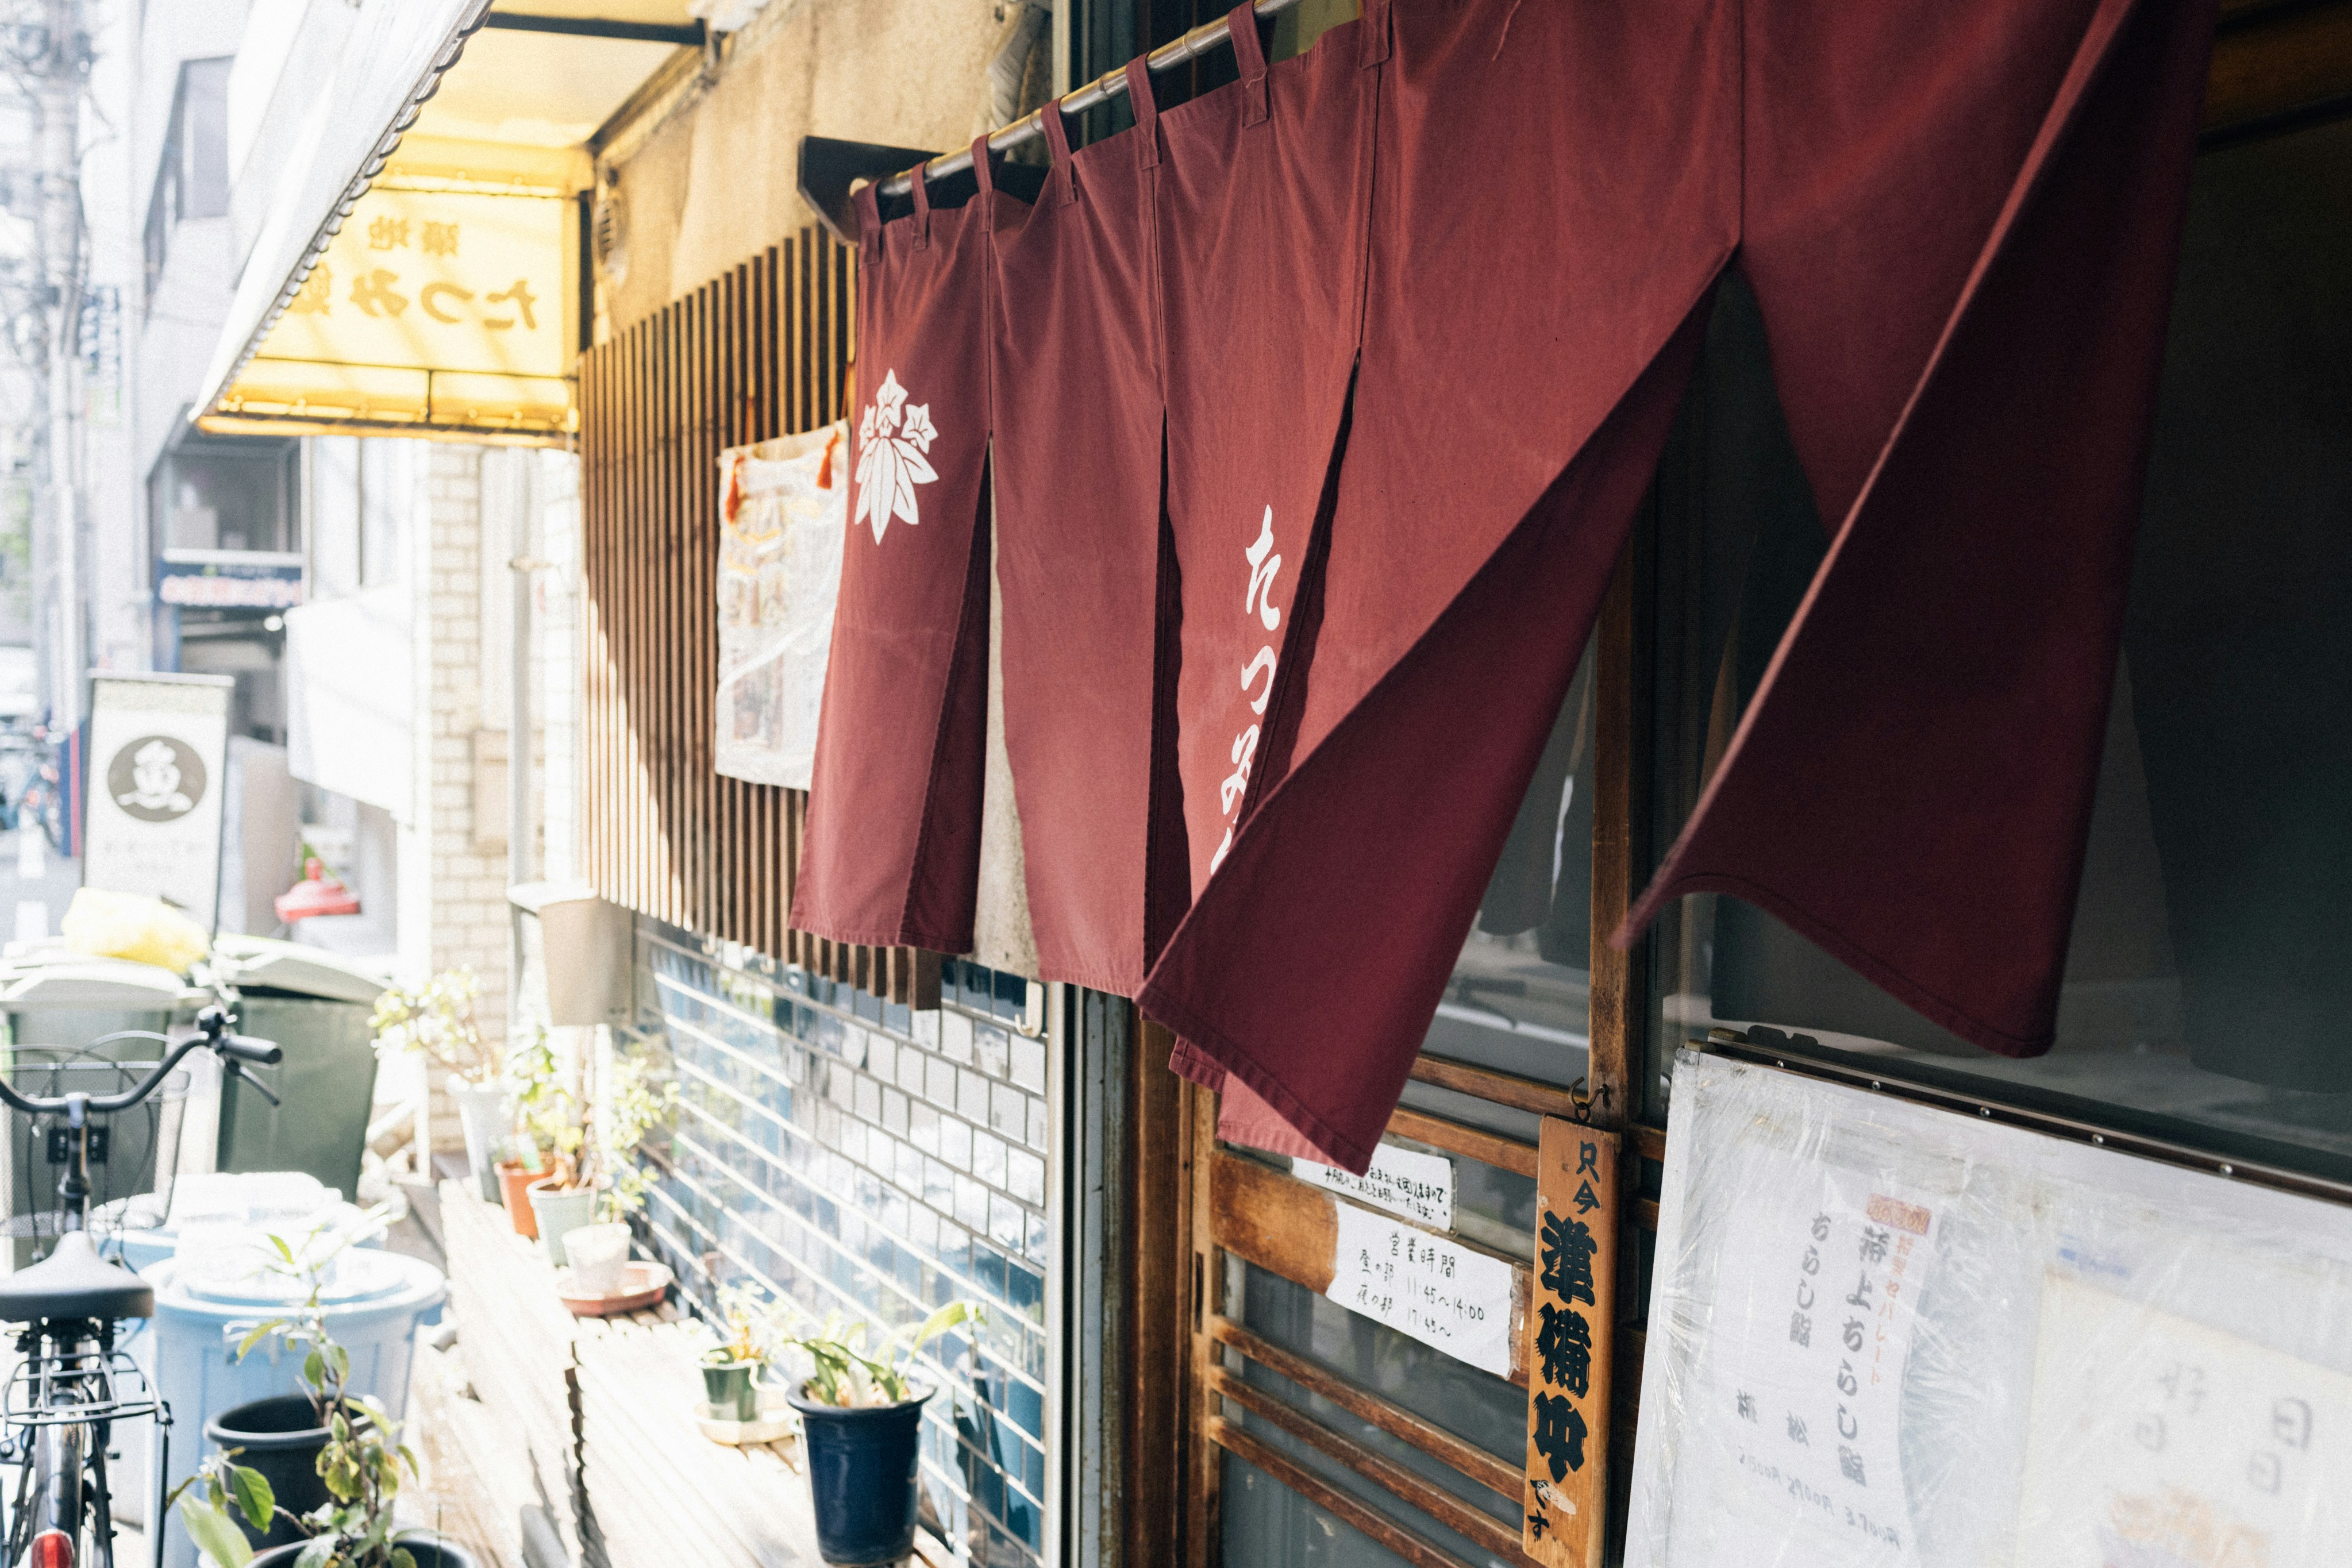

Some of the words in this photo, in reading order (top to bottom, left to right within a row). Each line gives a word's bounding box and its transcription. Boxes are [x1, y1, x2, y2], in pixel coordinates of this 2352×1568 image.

[1209, 504, 1281, 876] たつみ
[1360, 1249, 1394, 1288] 昼の部
[1389, 1231, 1455, 1279] 営業時間
